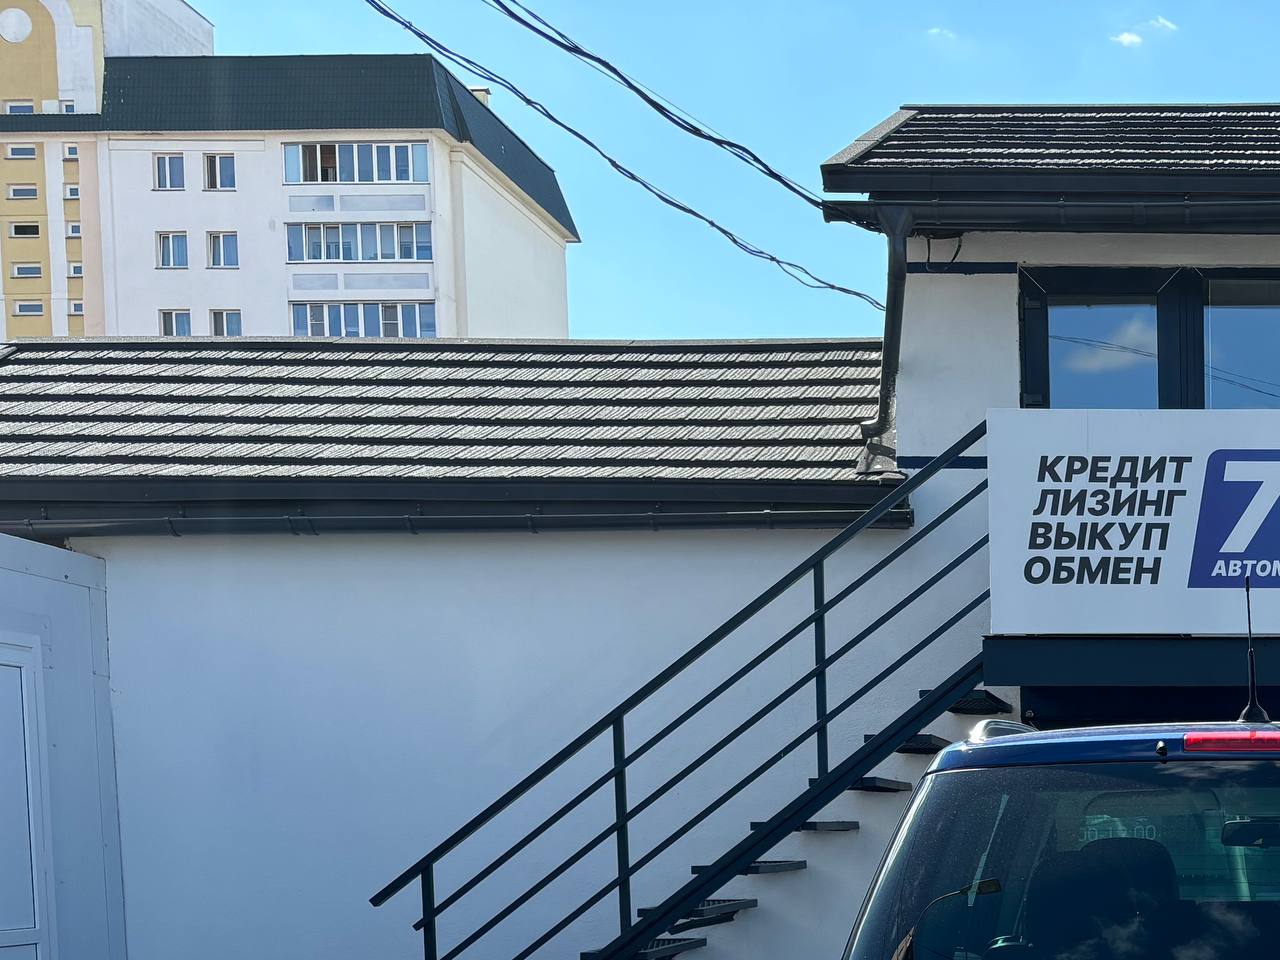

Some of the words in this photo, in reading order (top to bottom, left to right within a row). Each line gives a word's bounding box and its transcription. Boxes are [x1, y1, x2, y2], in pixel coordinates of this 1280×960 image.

[1037, 455, 1193, 489] КРЕДИТ
[1032, 488, 1188, 517] ЛИЗИНГ
[1027, 521, 1171, 551] ВЫКУП
[1023, 555, 1163, 585] ОБМЕН
